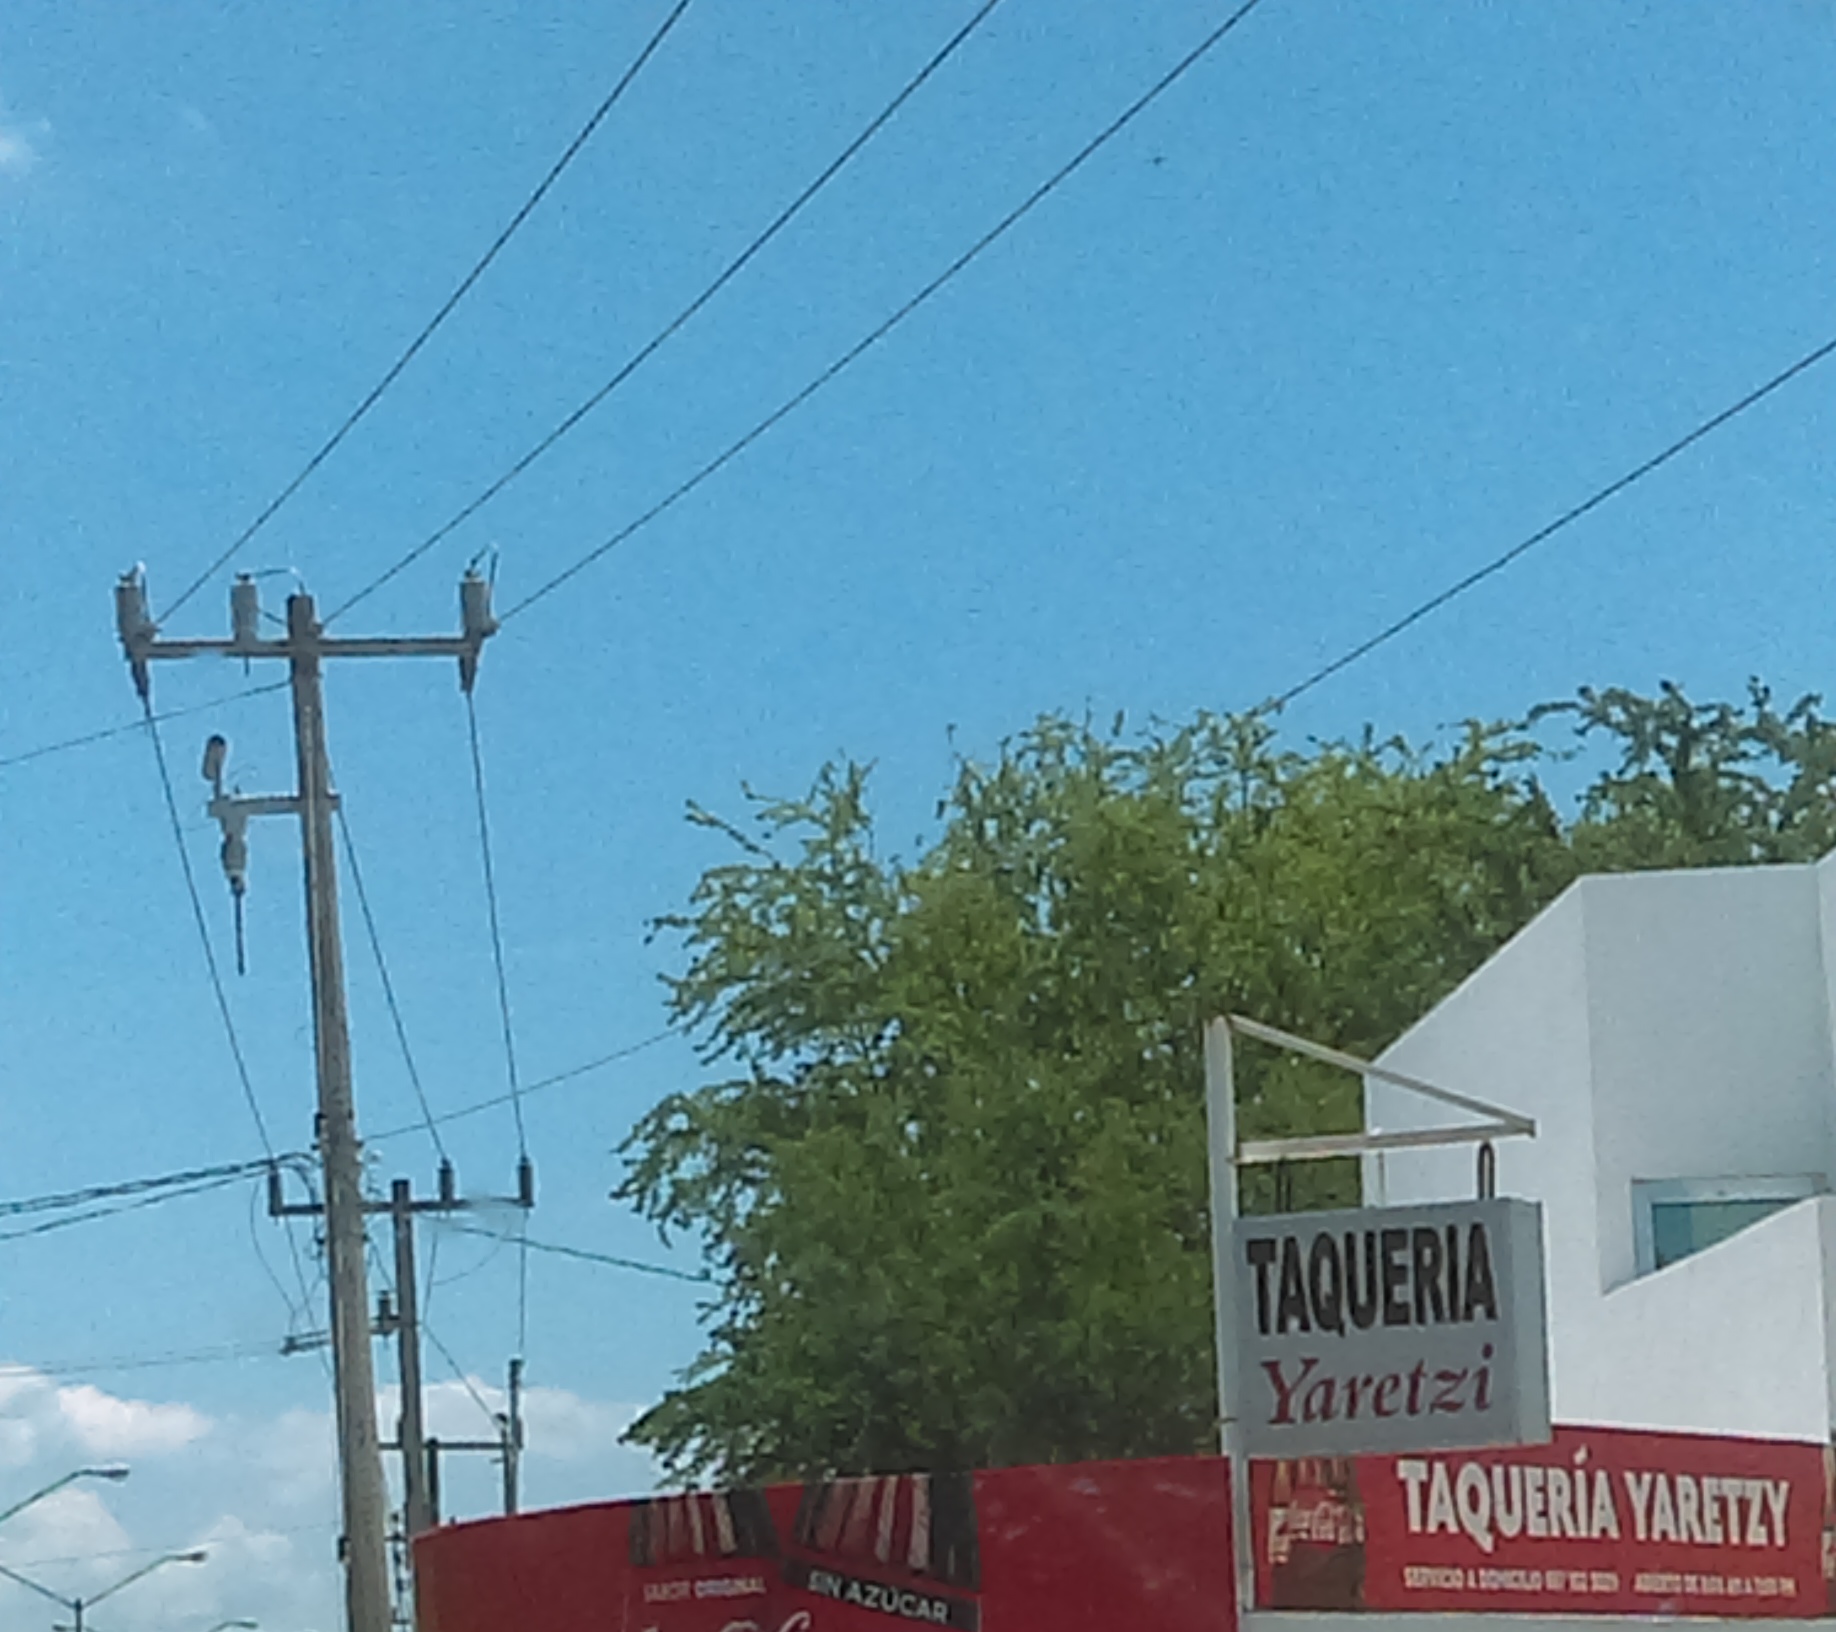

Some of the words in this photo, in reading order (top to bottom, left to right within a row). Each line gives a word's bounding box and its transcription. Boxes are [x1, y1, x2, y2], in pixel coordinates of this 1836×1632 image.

[1246, 1223, 1497, 1337] TAQUERIA
[1261, 1343, 1494, 1424] Yaretzi
[1397, 1444, 1620, 1553] TAQUERÍA
[1624, 1471, 1790, 1547] YARETZY
[808, 1570, 841, 1599] SIN
